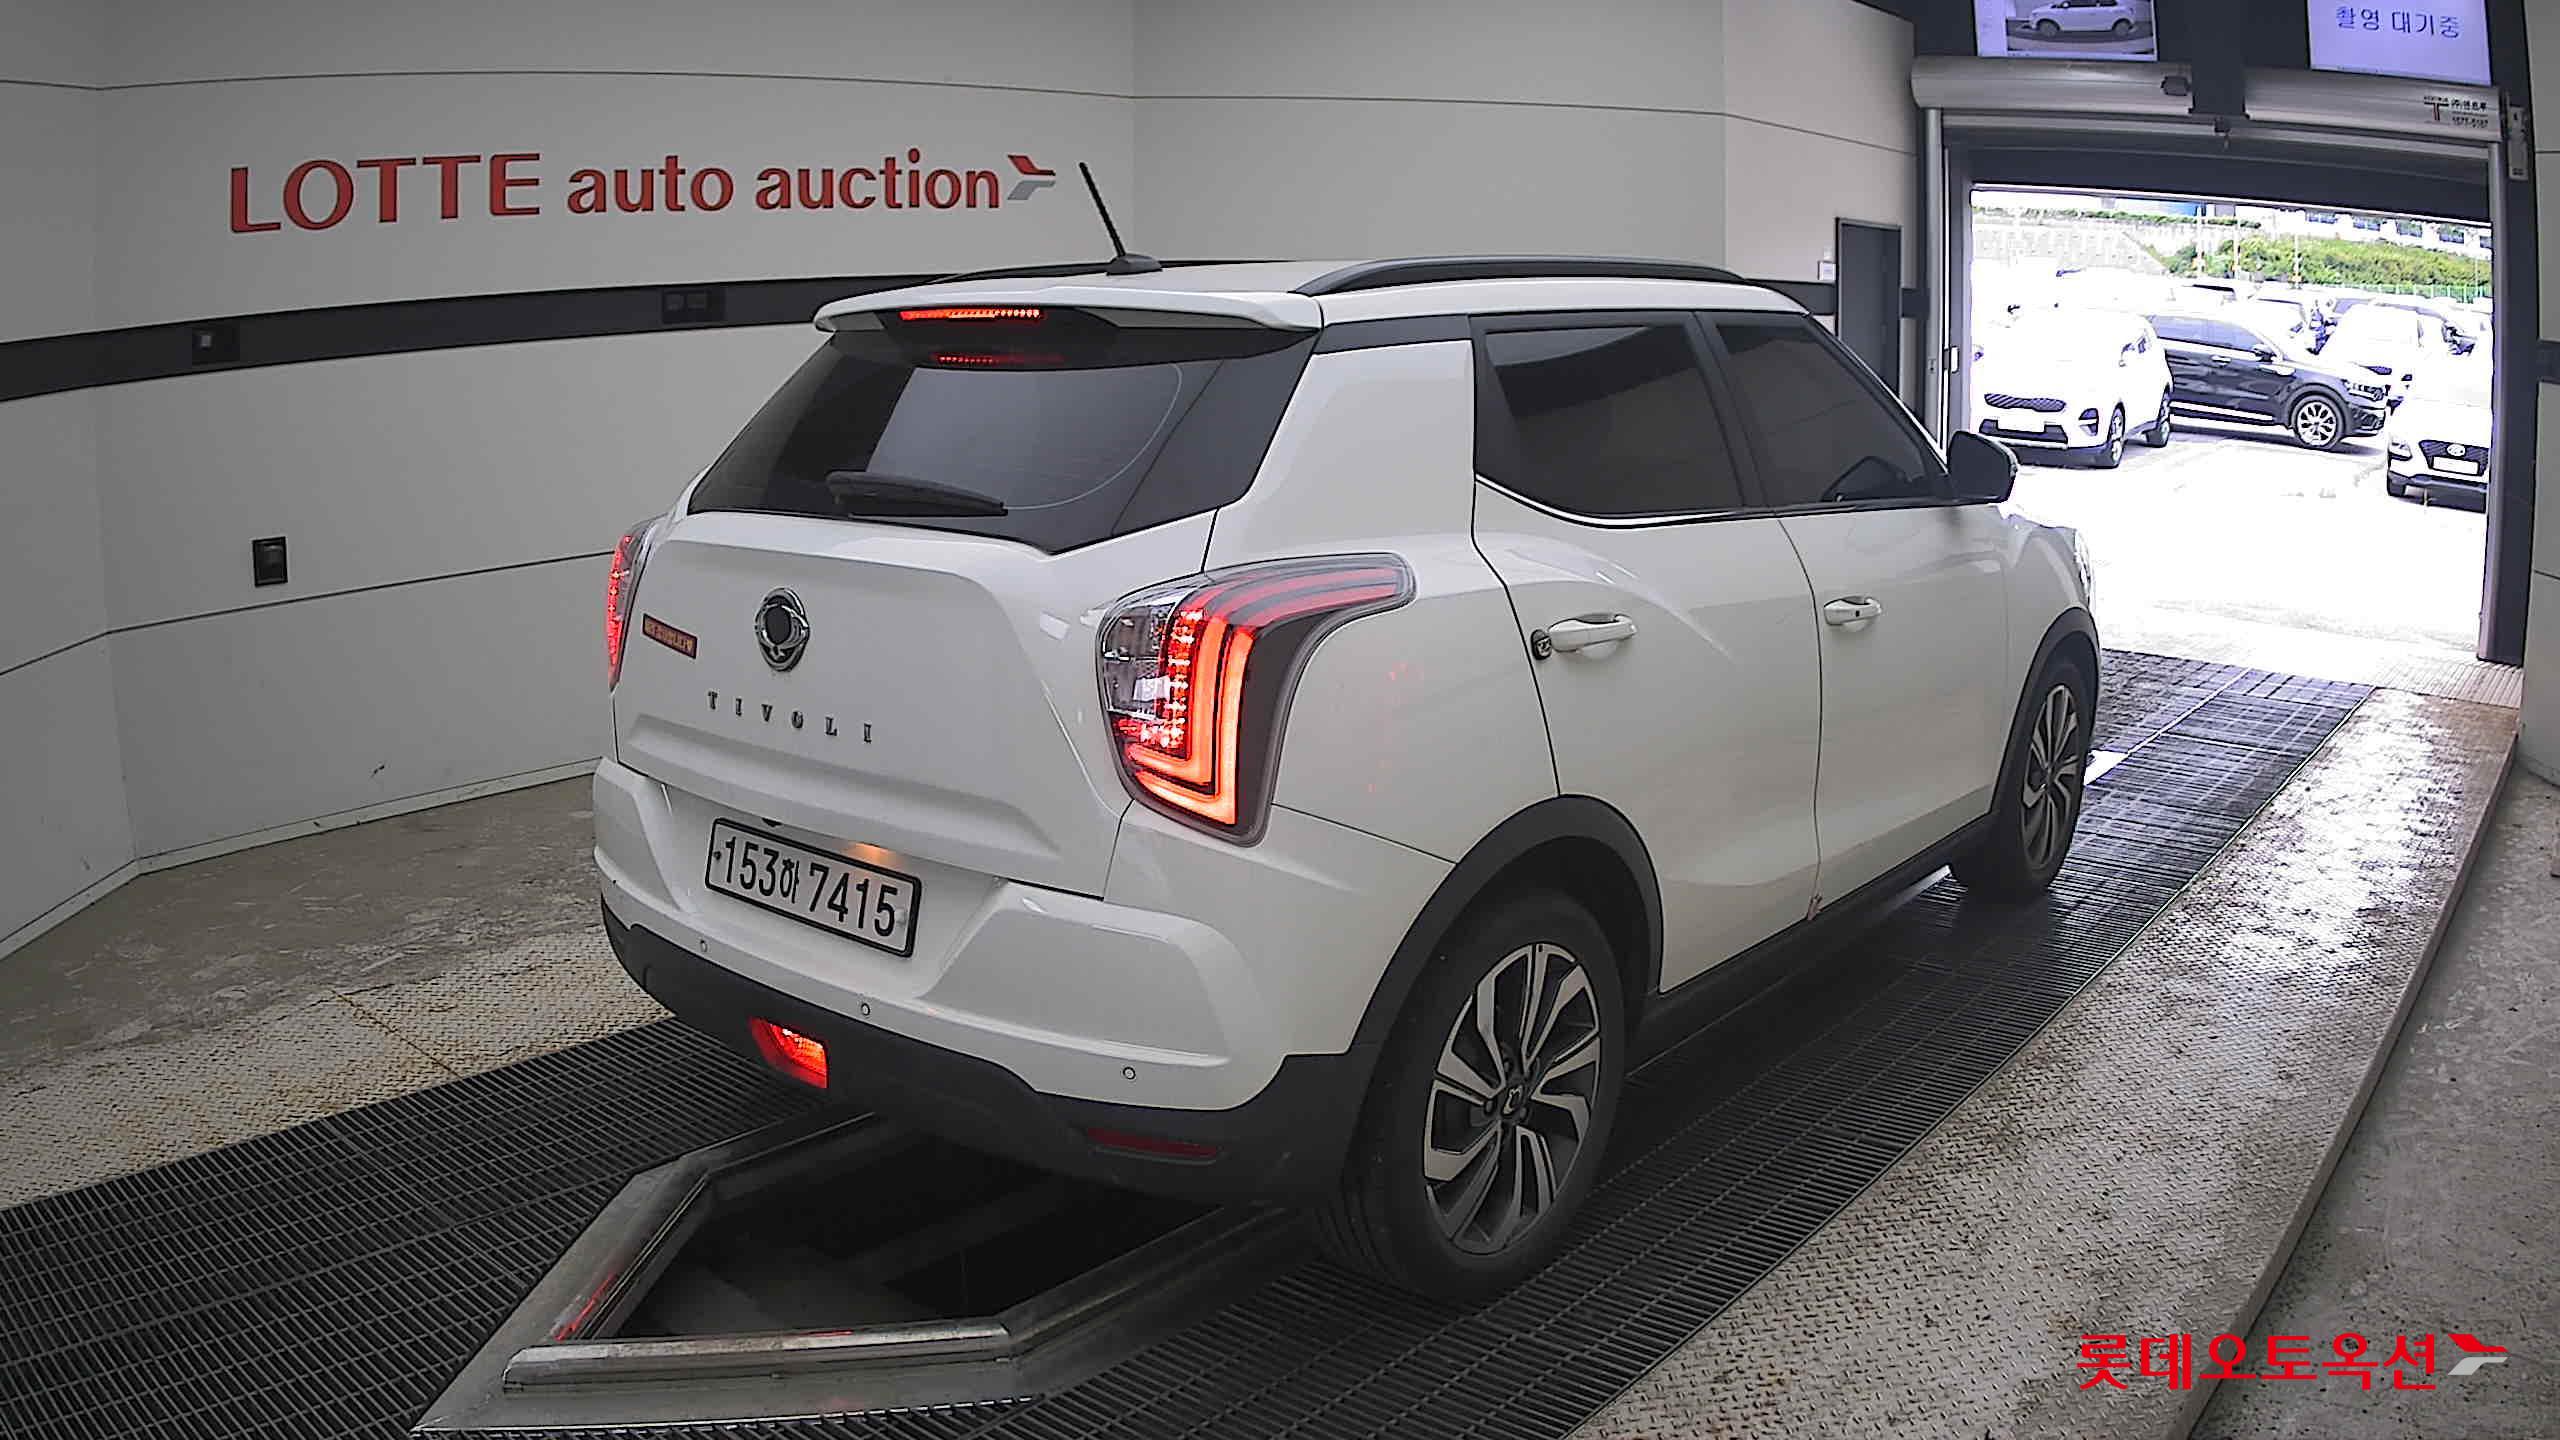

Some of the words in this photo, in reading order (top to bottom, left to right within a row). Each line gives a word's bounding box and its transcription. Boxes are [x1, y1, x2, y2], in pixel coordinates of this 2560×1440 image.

[2336, 5, 2380, 31] 촬영
[2391, 11, 2460, 39] 대기중
[230, 152, 541, 233] LOTTE
[567, 154, 735, 215] auto
[754, 147, 1001, 211] auction
[707, 690, 872, 744] TIVOLI
[724, 835, 800, 904] 153하
[808, 861, 899, 938] 7415
